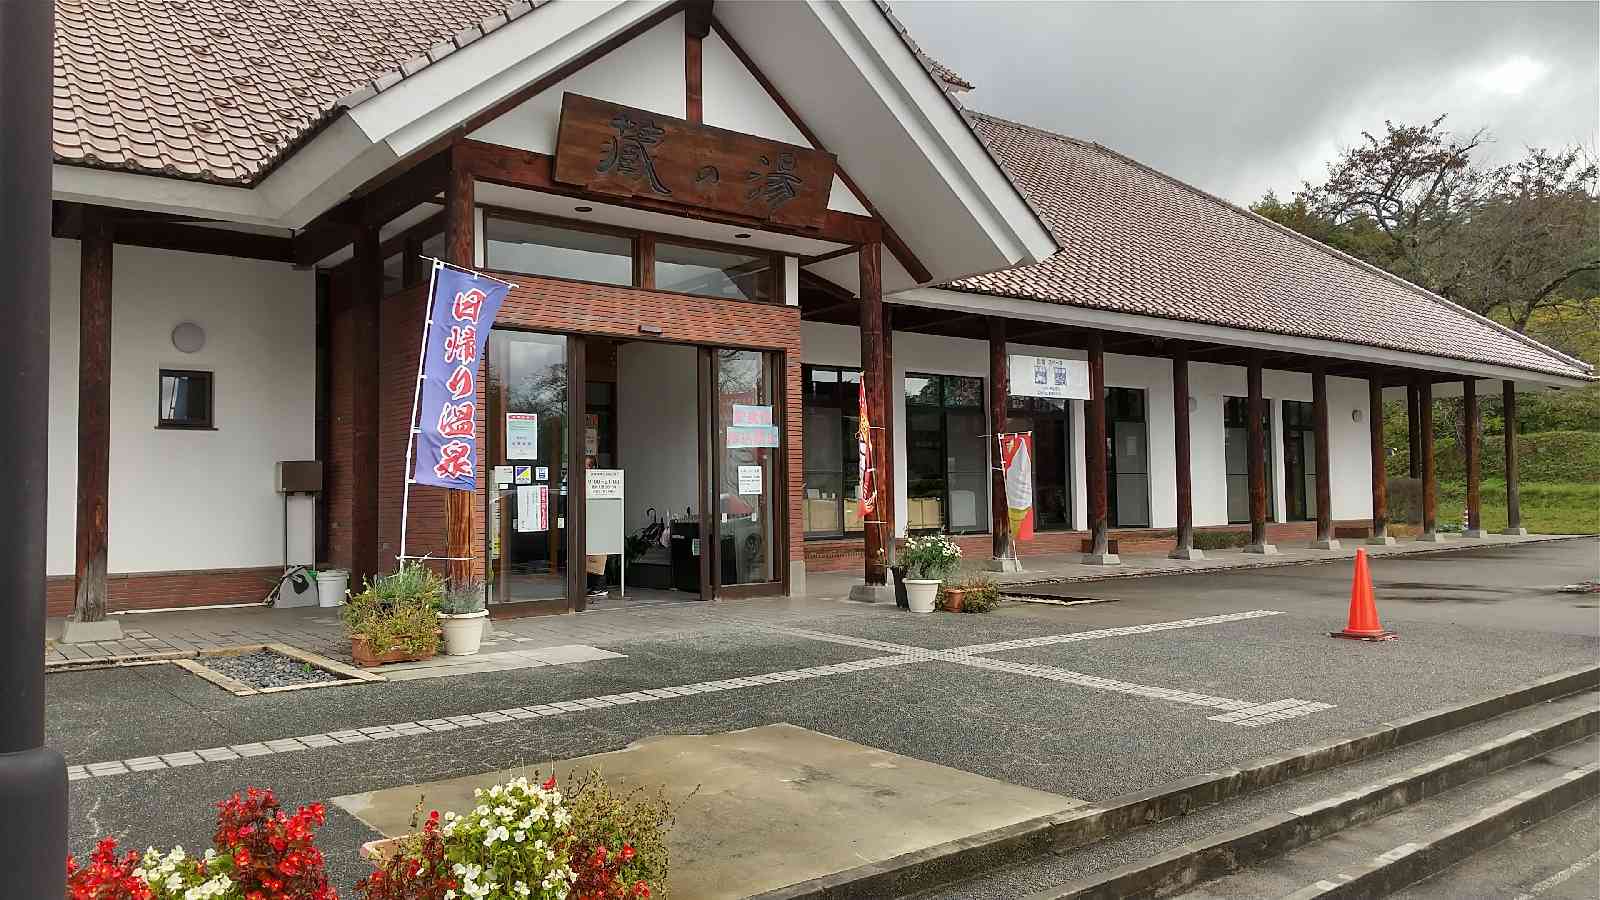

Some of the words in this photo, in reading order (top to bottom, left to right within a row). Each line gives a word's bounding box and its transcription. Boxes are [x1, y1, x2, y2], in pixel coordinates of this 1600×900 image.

[434, 288, 487, 479] 日帰り温泉
